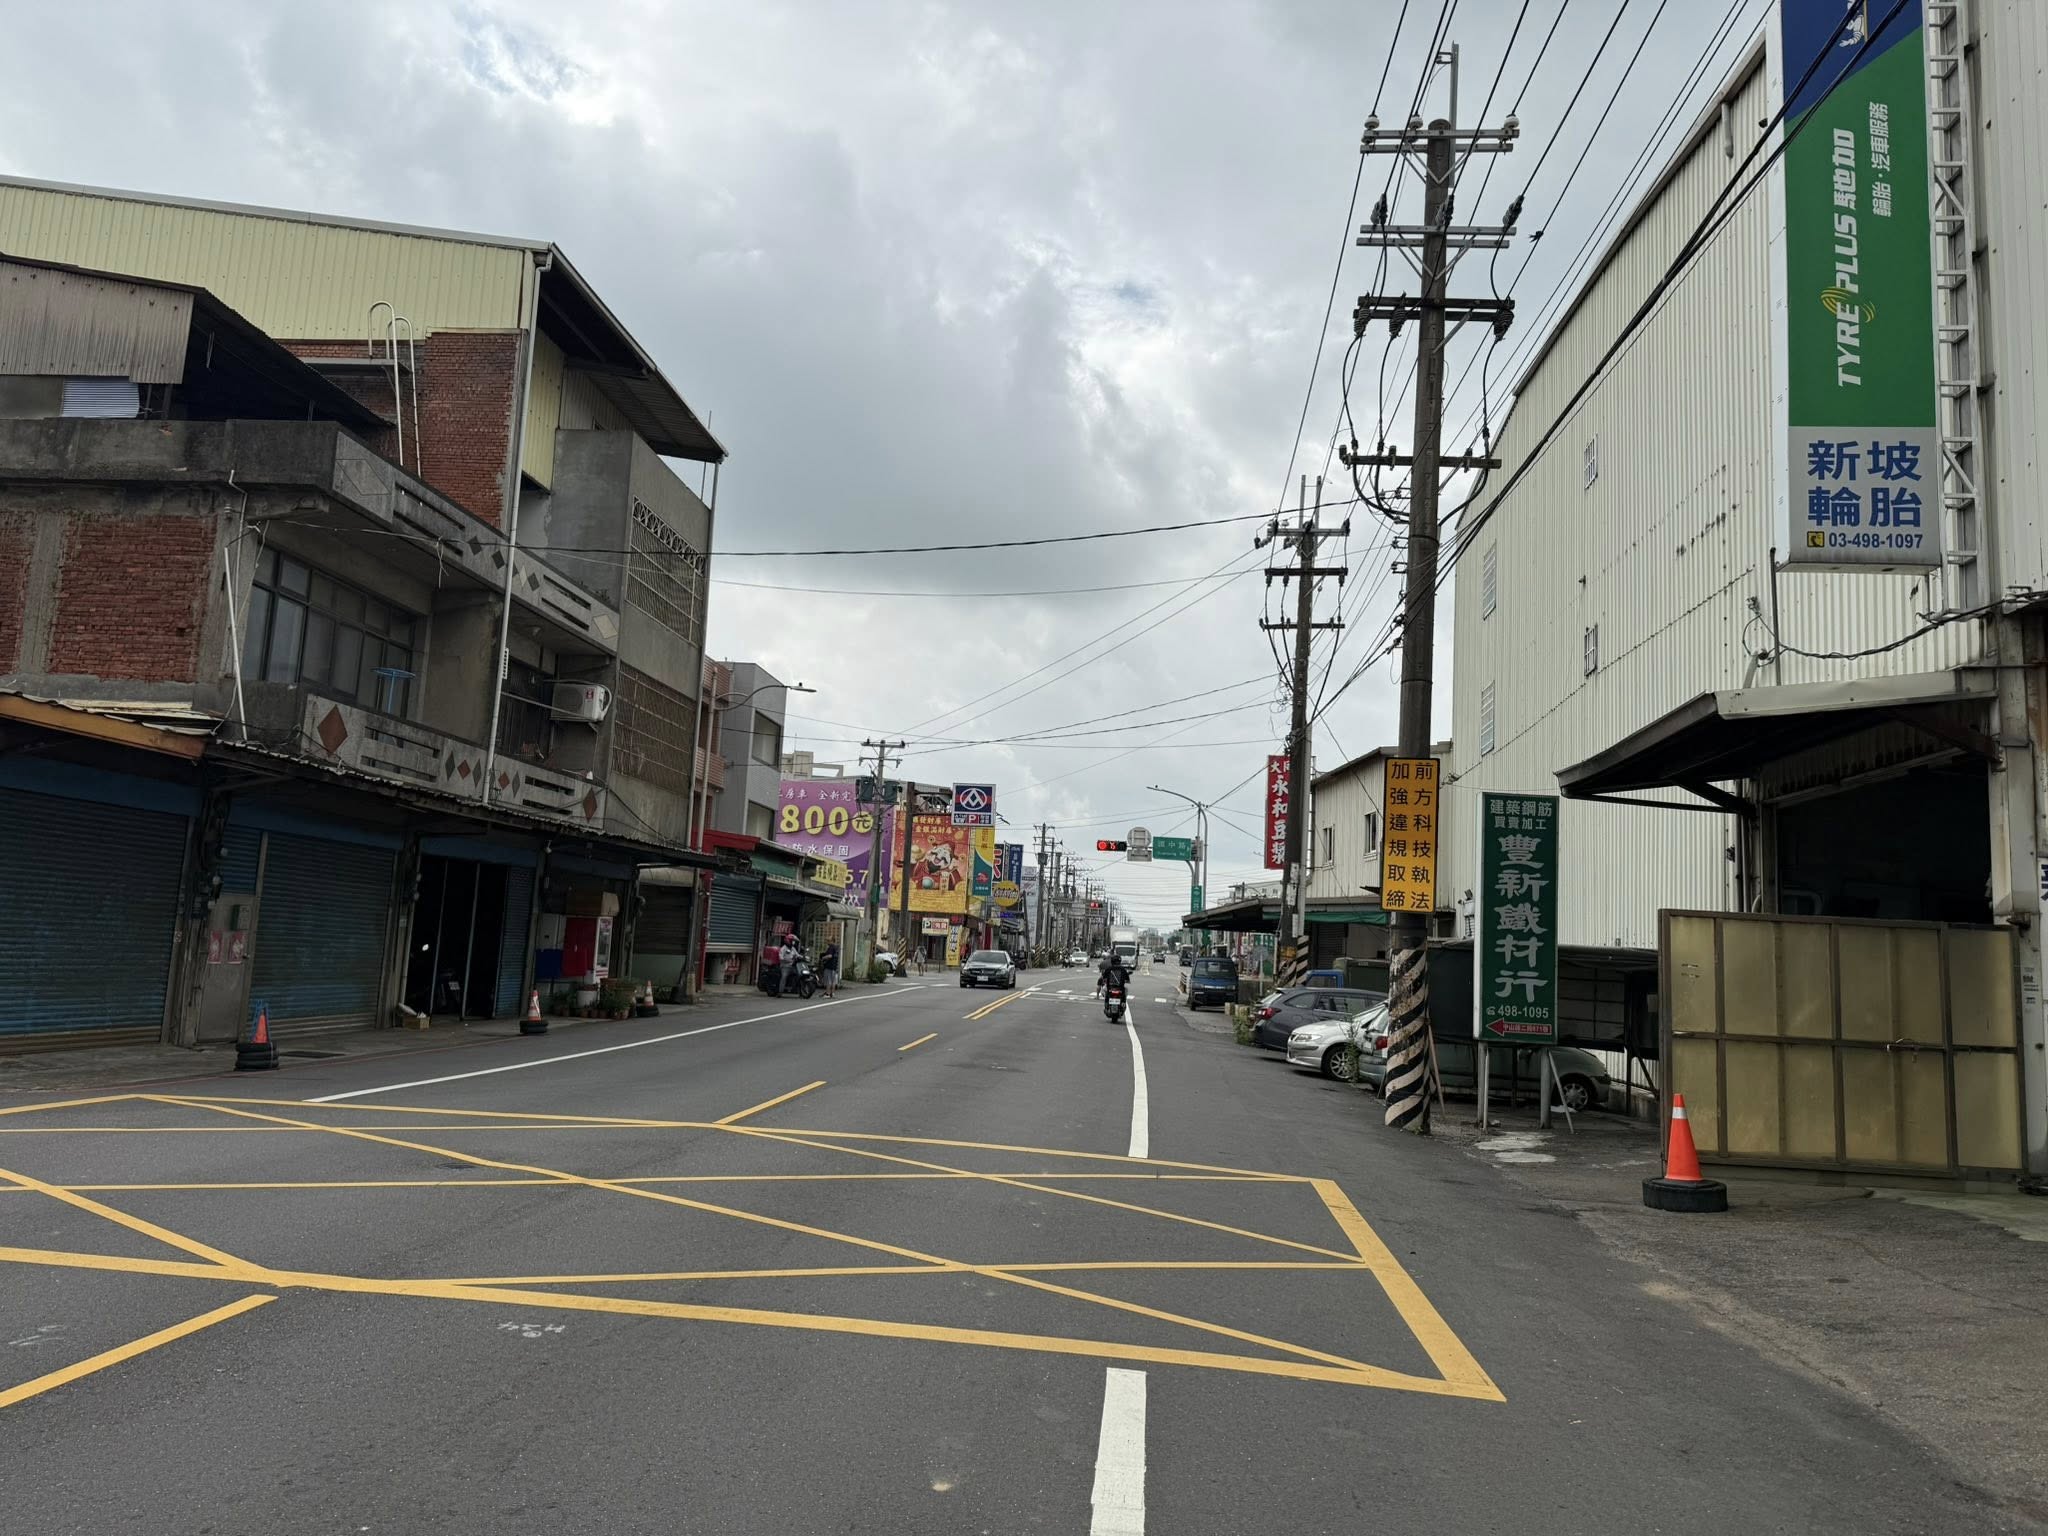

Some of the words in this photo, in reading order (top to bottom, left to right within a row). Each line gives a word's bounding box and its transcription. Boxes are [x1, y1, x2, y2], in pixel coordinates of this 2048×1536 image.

[1833, 128, 1857, 211] 馳加
[1834, 212, 1859, 294] PLUS
[1837, 302, 1861, 387] TYRE
[1807, 440, 1922, 481] 新坡
[1807, 486, 1922, 527] 輪胎
[1828, 532, 1923, 549] 03-498-1097
[819, 790, 857, 801] 全新完
[1490, 799, 1553, 817] 建築鋼筋
[1271, 774, 1288, 865] 永和豆漿
[1386, 762, 1410, 909] 加強違規取締
[1410, 762, 1434, 910] 前方科技執法
[1494, 816, 1547, 830] 買賣加工
[783, 843, 849, 856] 防水保固
[1493, 833, 1550, 1003] 豐新鐵材行
[1497, 1004, 1550, 1019] 498-1095
